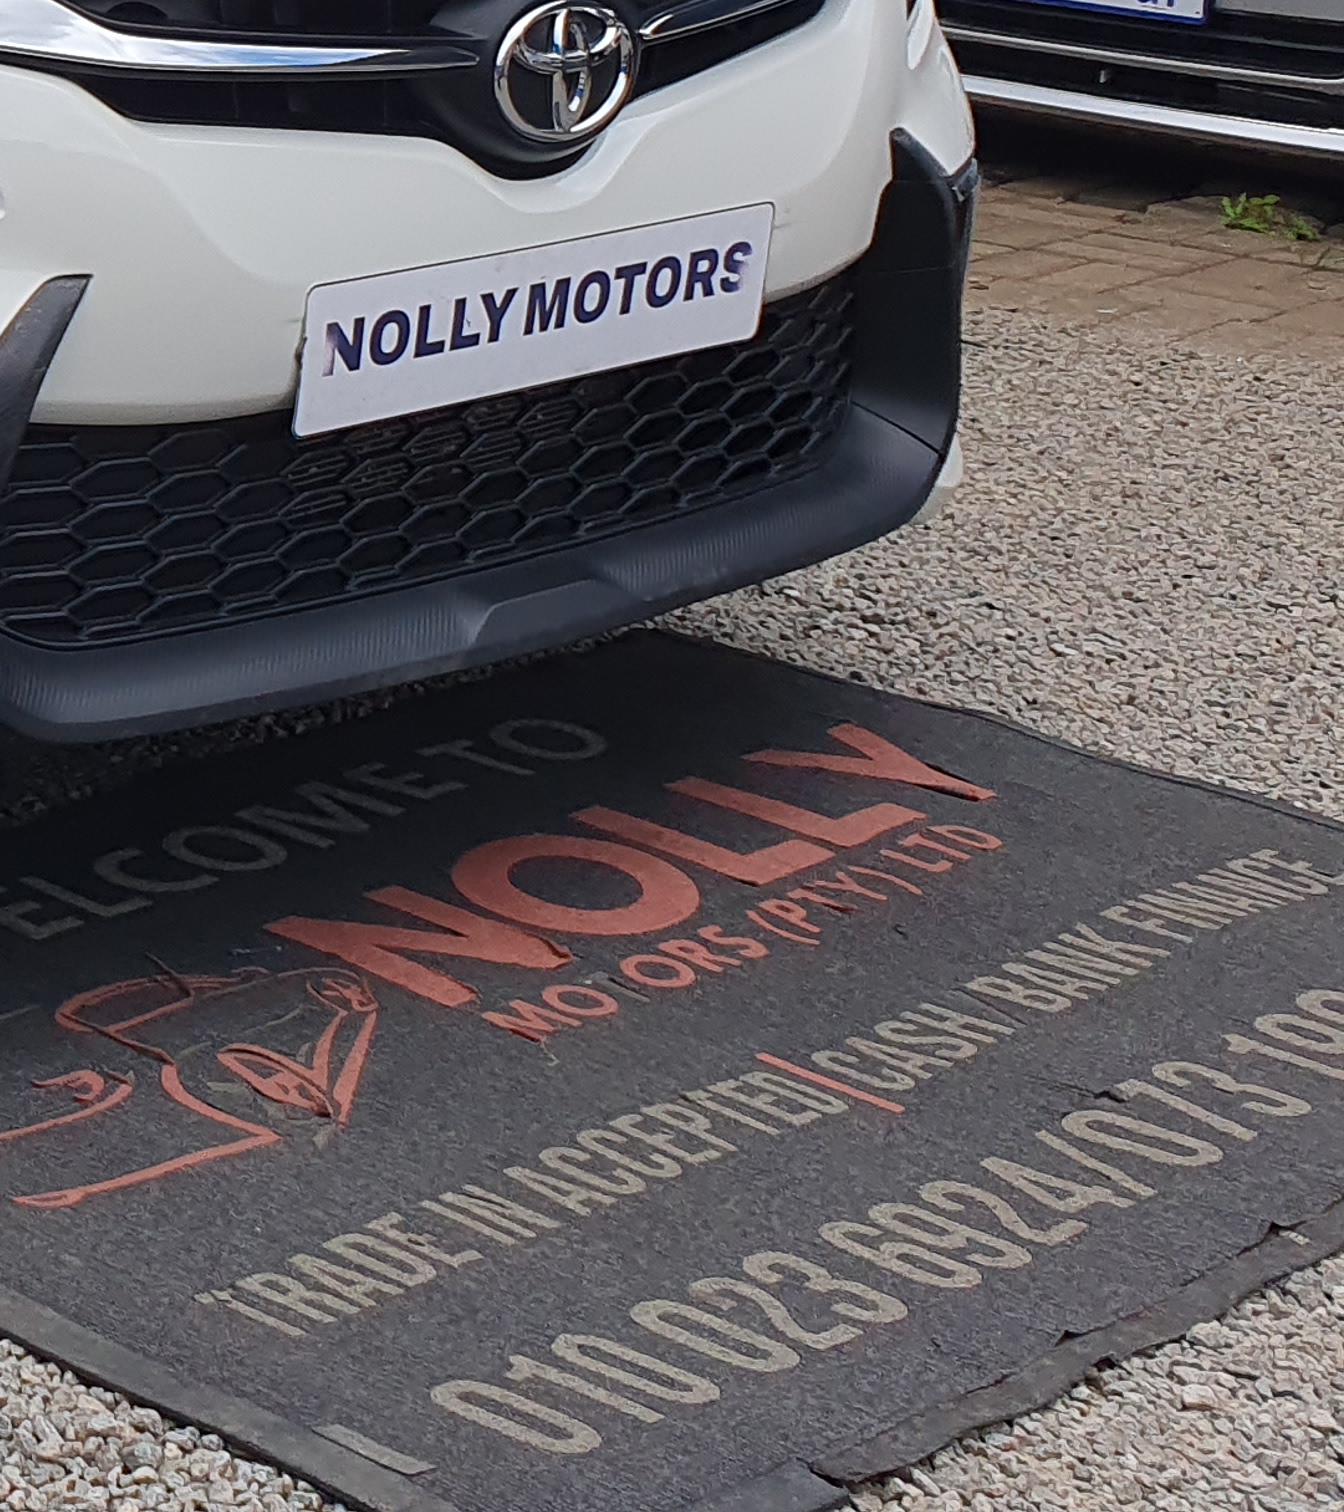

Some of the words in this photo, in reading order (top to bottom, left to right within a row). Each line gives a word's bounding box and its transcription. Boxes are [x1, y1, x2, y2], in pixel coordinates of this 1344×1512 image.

[321, 287, 519, 377] NOLLY
[522, 240, 753, 336] MOTORS
[422, 716, 606, 776] TO
[264, 722, 998, 1007] NOLLY
[746, 865, 924, 946] (PTY)
[879, 824, 1004, 872] LTD
[195, 1210, 482, 1338] TRADE
[418, 1184, 563, 1245] IN
[502, 1069, 849, 1218] ACCEPTED
[1099, 848, 1343, 944] FINANCE
[429, 1332, 721, 1455] 010
[629, 1249, 909, 1375] 023
